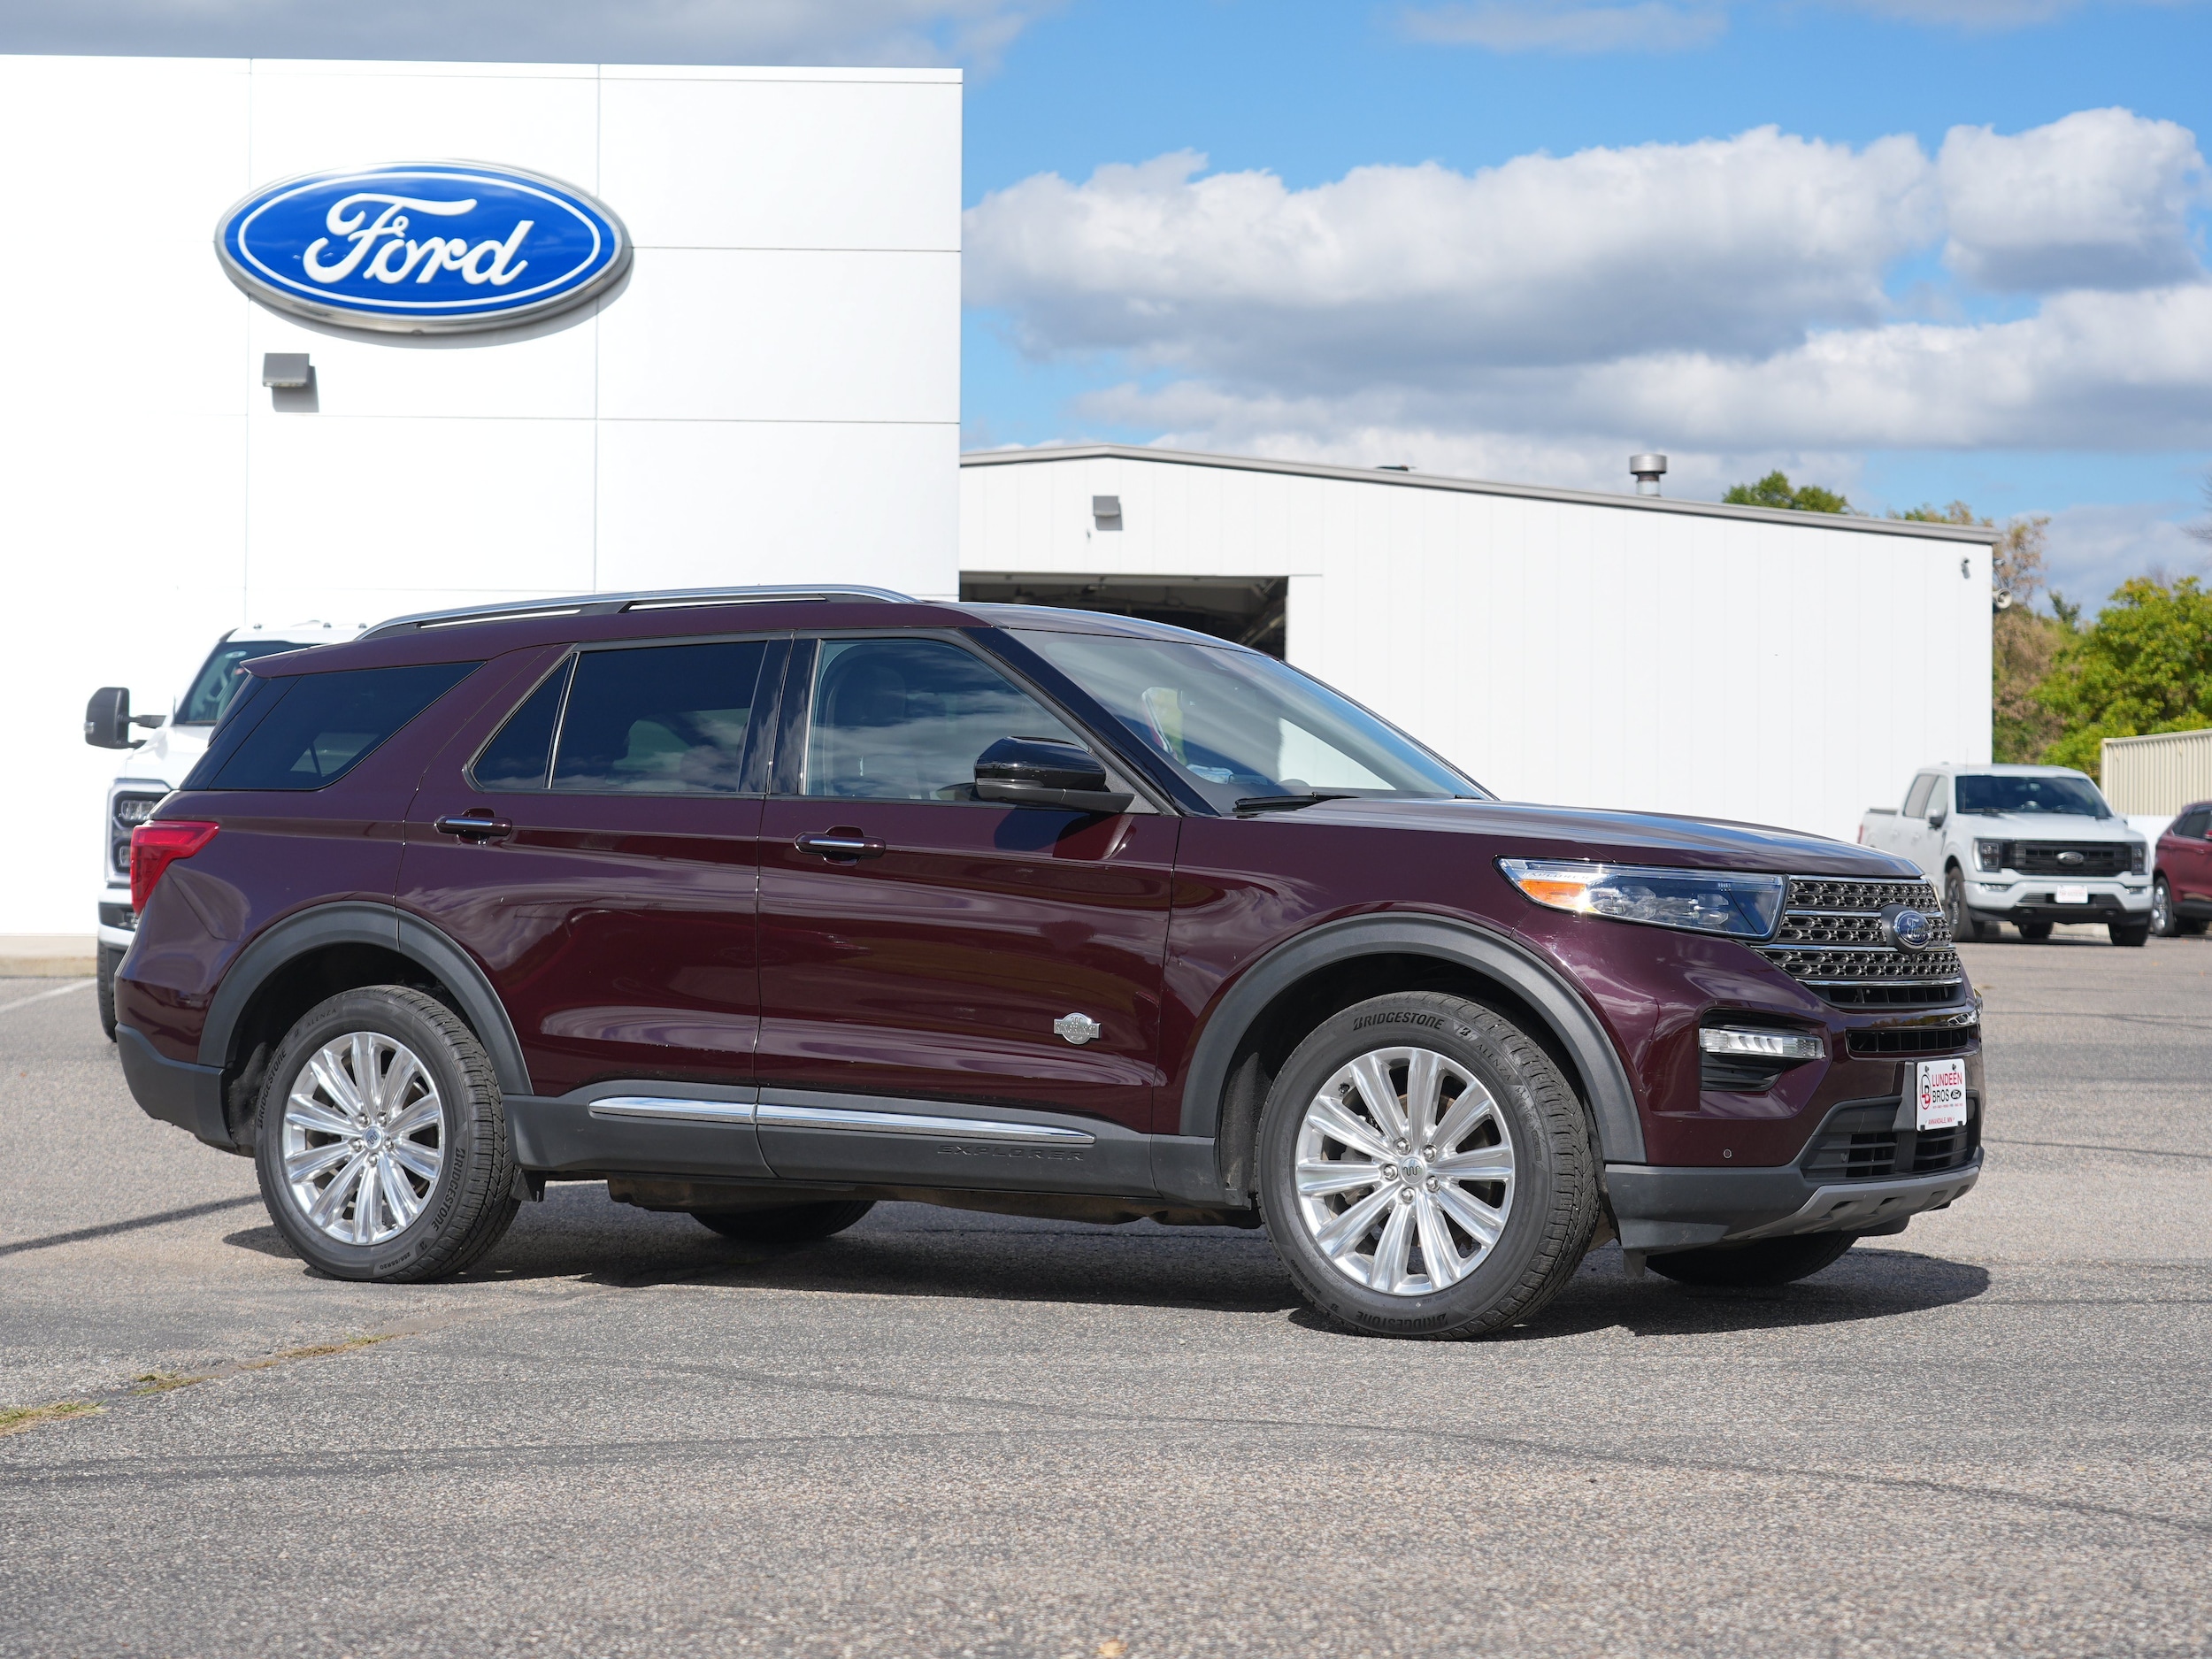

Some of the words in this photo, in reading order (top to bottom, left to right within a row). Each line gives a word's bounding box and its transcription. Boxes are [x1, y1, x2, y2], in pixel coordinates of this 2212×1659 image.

[303, 192, 534, 286] Ford
[1353, 1011, 1445, 1032] BRIDGESTONE
[1476, 1044, 1511, 1081] ALENZA
[1932, 1071, 1962, 1087] LUNDEEN
[1932, 1088, 1950, 1103] BROS
[937, 1145, 1084, 1162] EXPLORER
[432, 1147, 465, 1232] BRIDGESTONE
